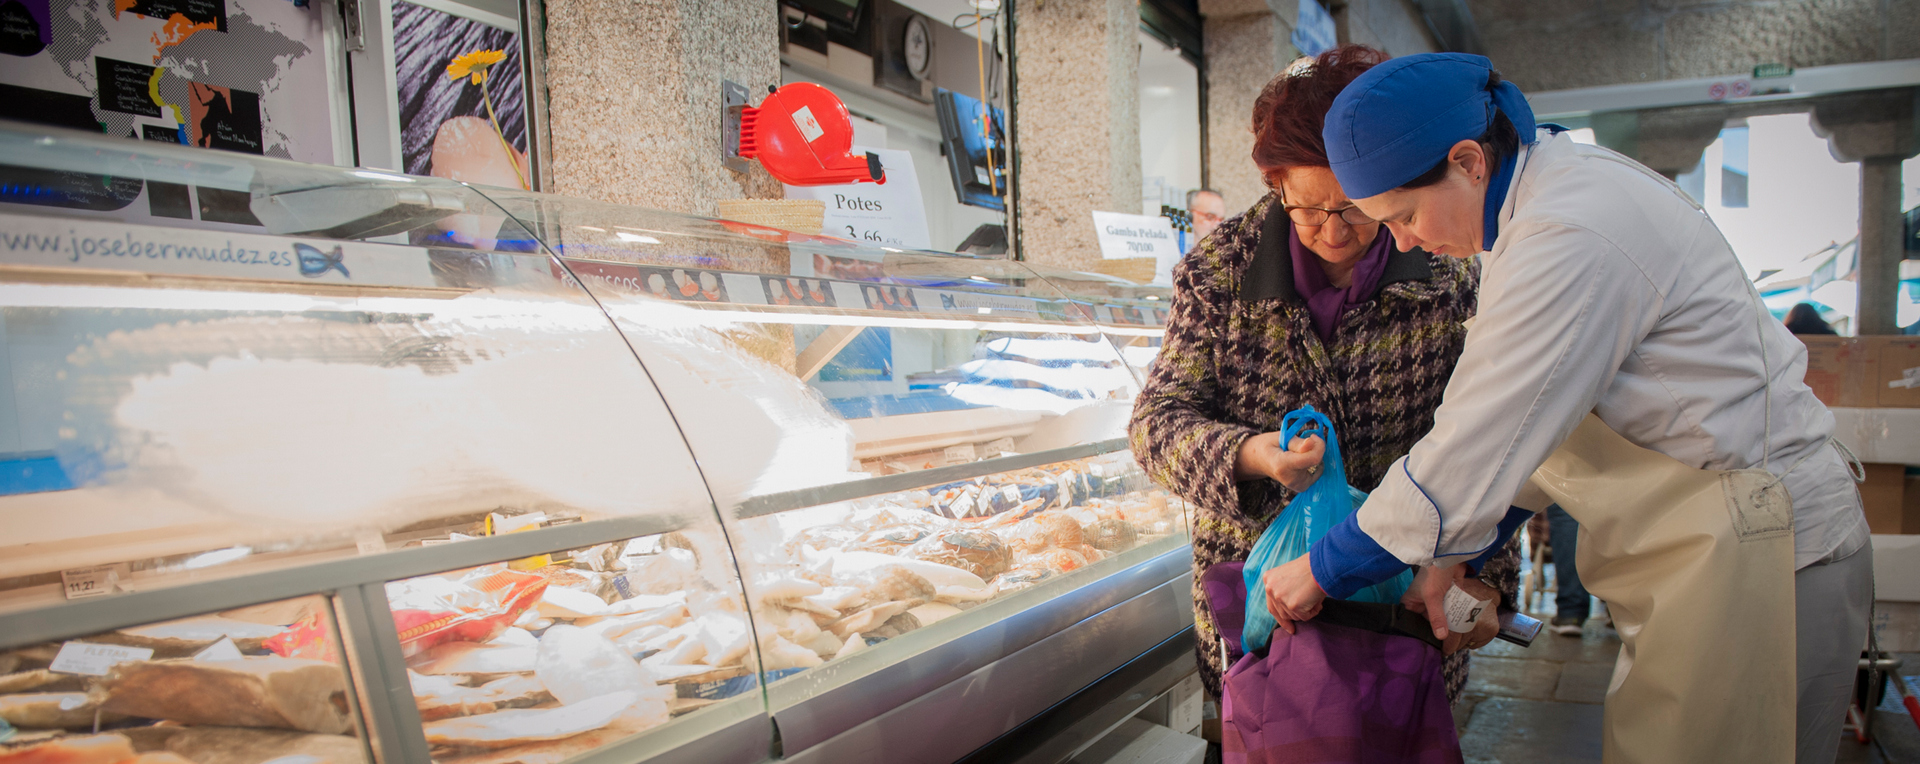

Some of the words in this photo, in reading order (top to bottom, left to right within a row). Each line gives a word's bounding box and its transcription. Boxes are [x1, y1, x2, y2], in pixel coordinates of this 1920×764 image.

[834, 193, 882, 211] Potes
[1106, 225, 1138, 238] Gamba
[1138, 228, 1168, 240] Pelada
[1126, 241, 1154, 253] 70/100
[69, 580, 95, 592] 11,27
